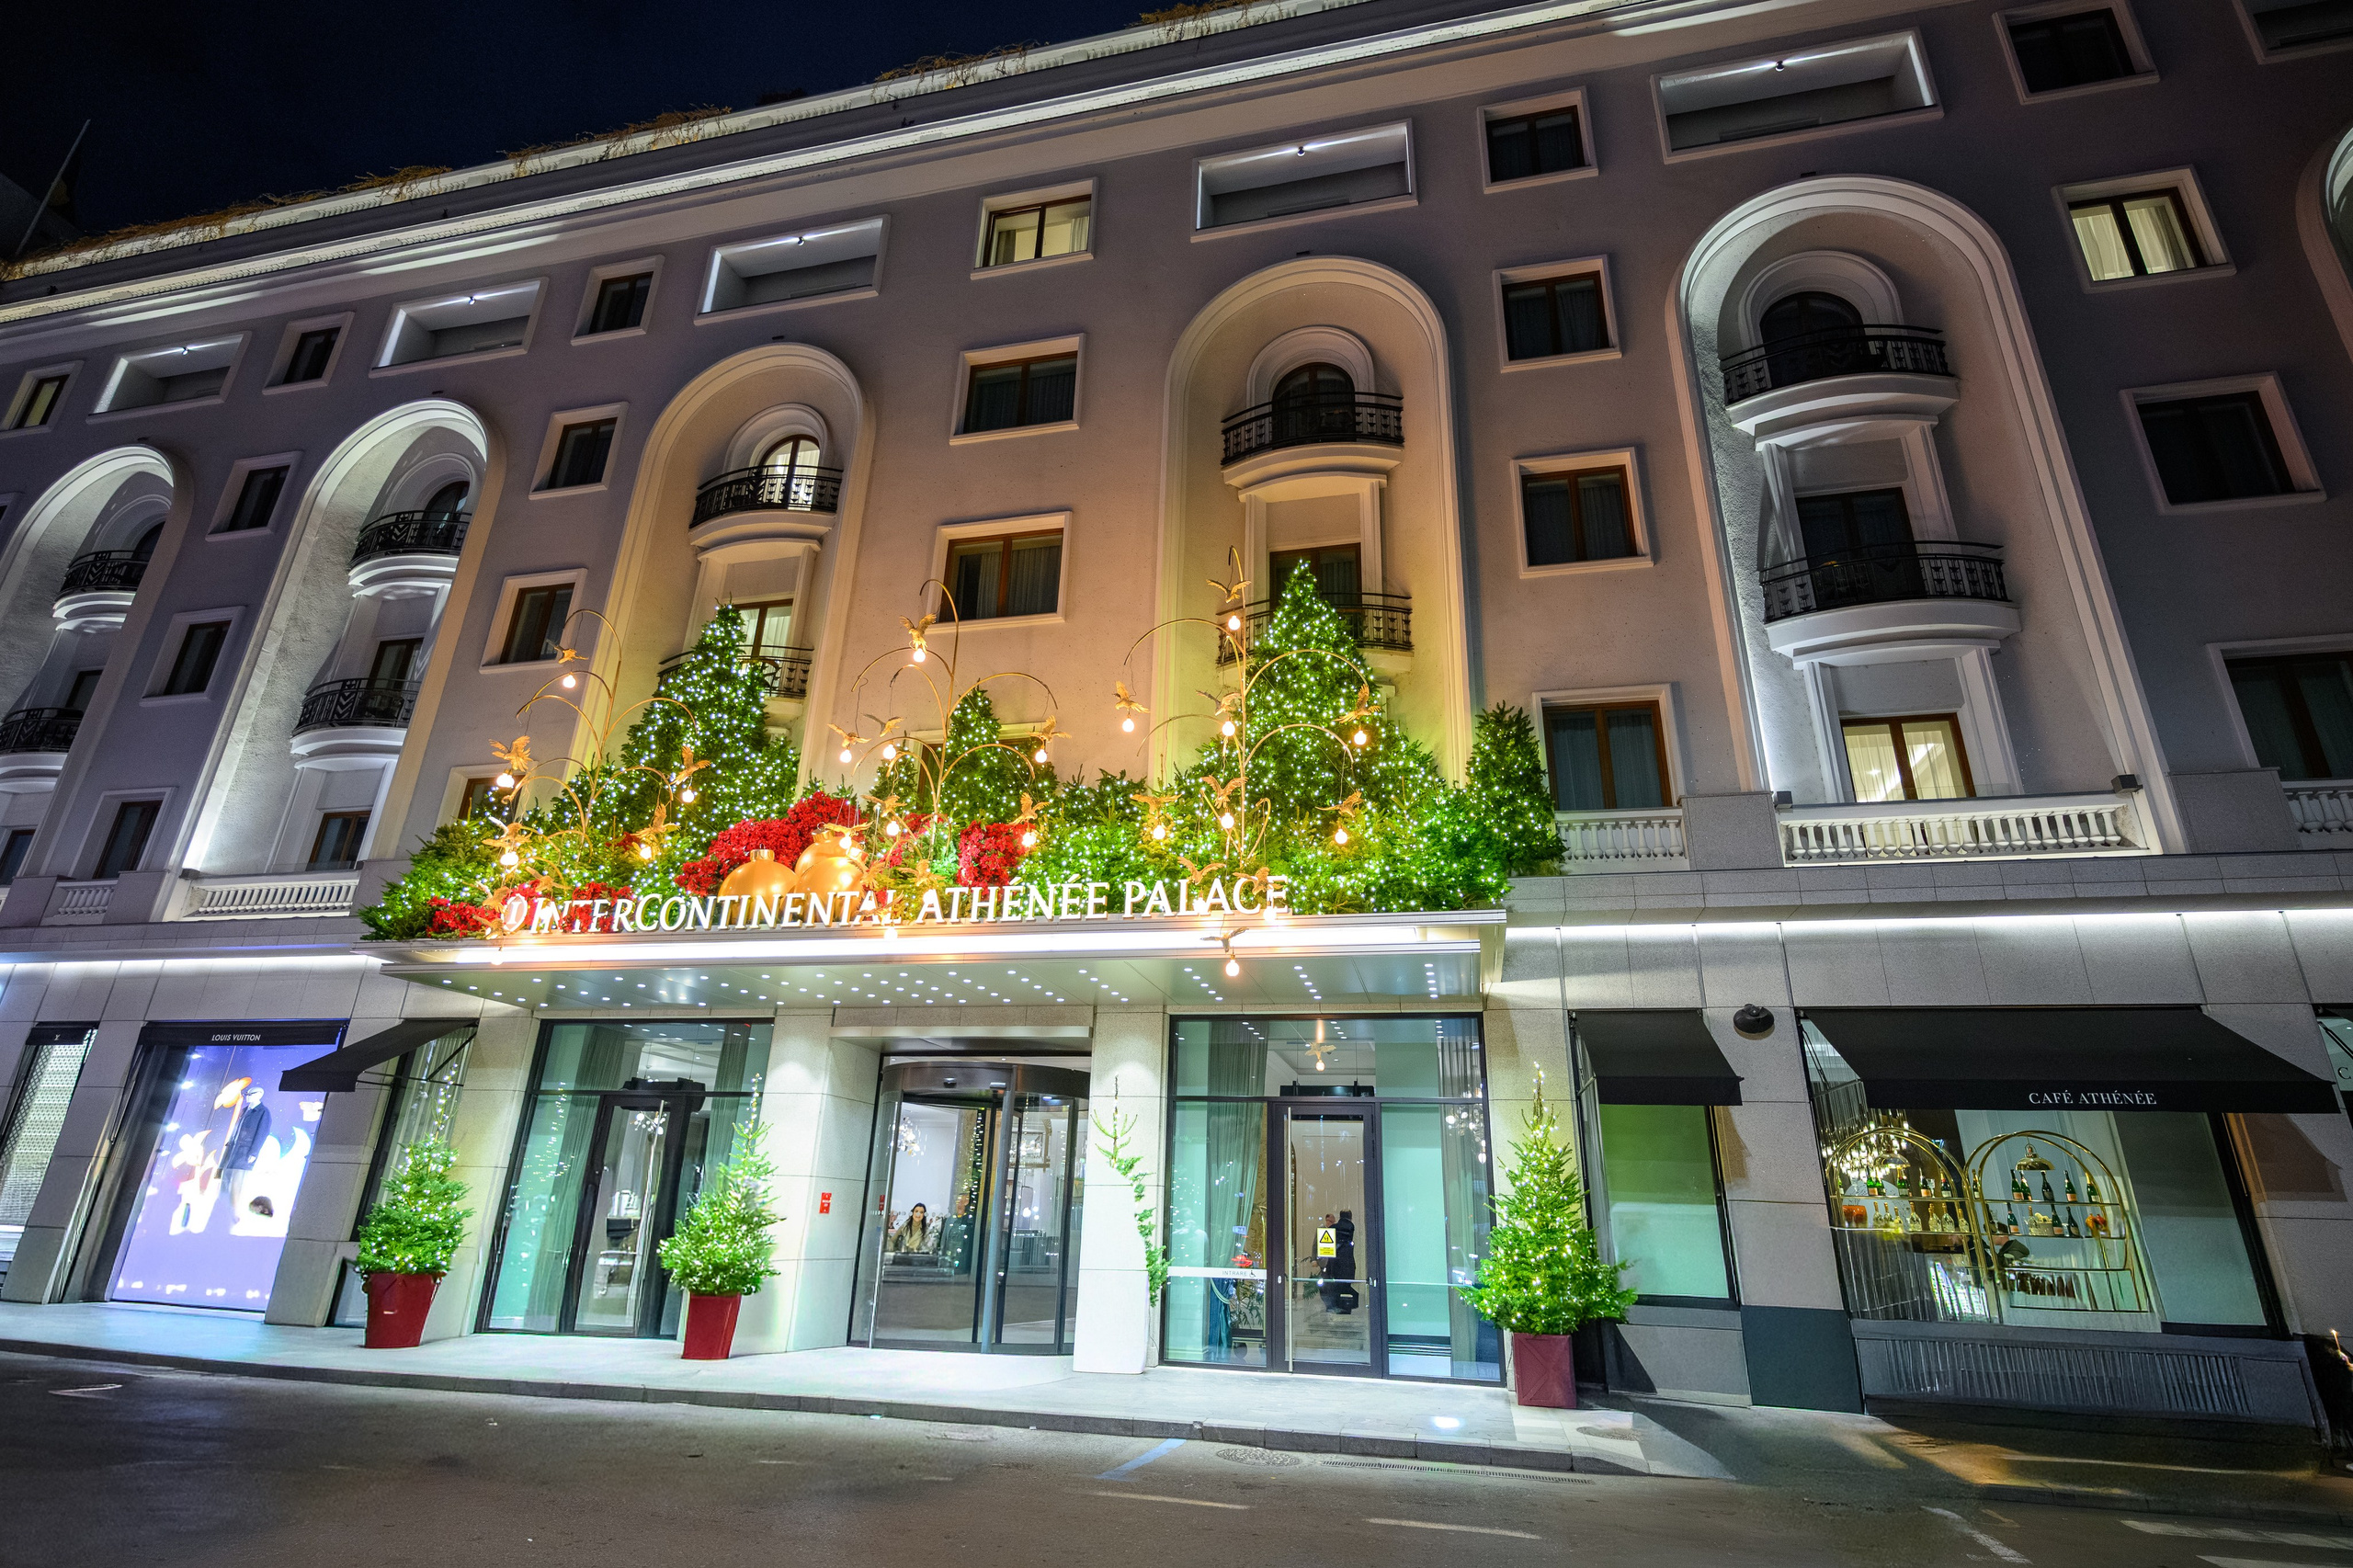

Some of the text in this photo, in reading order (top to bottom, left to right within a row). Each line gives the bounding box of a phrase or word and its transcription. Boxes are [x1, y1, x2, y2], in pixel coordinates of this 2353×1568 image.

[916, 877, 1109, 923] ATHÉNÉE
[1121, 876, 1288, 918] PALACE
[2029, 1089, 2157, 1105] CAFÉ ATHÉNÉE
